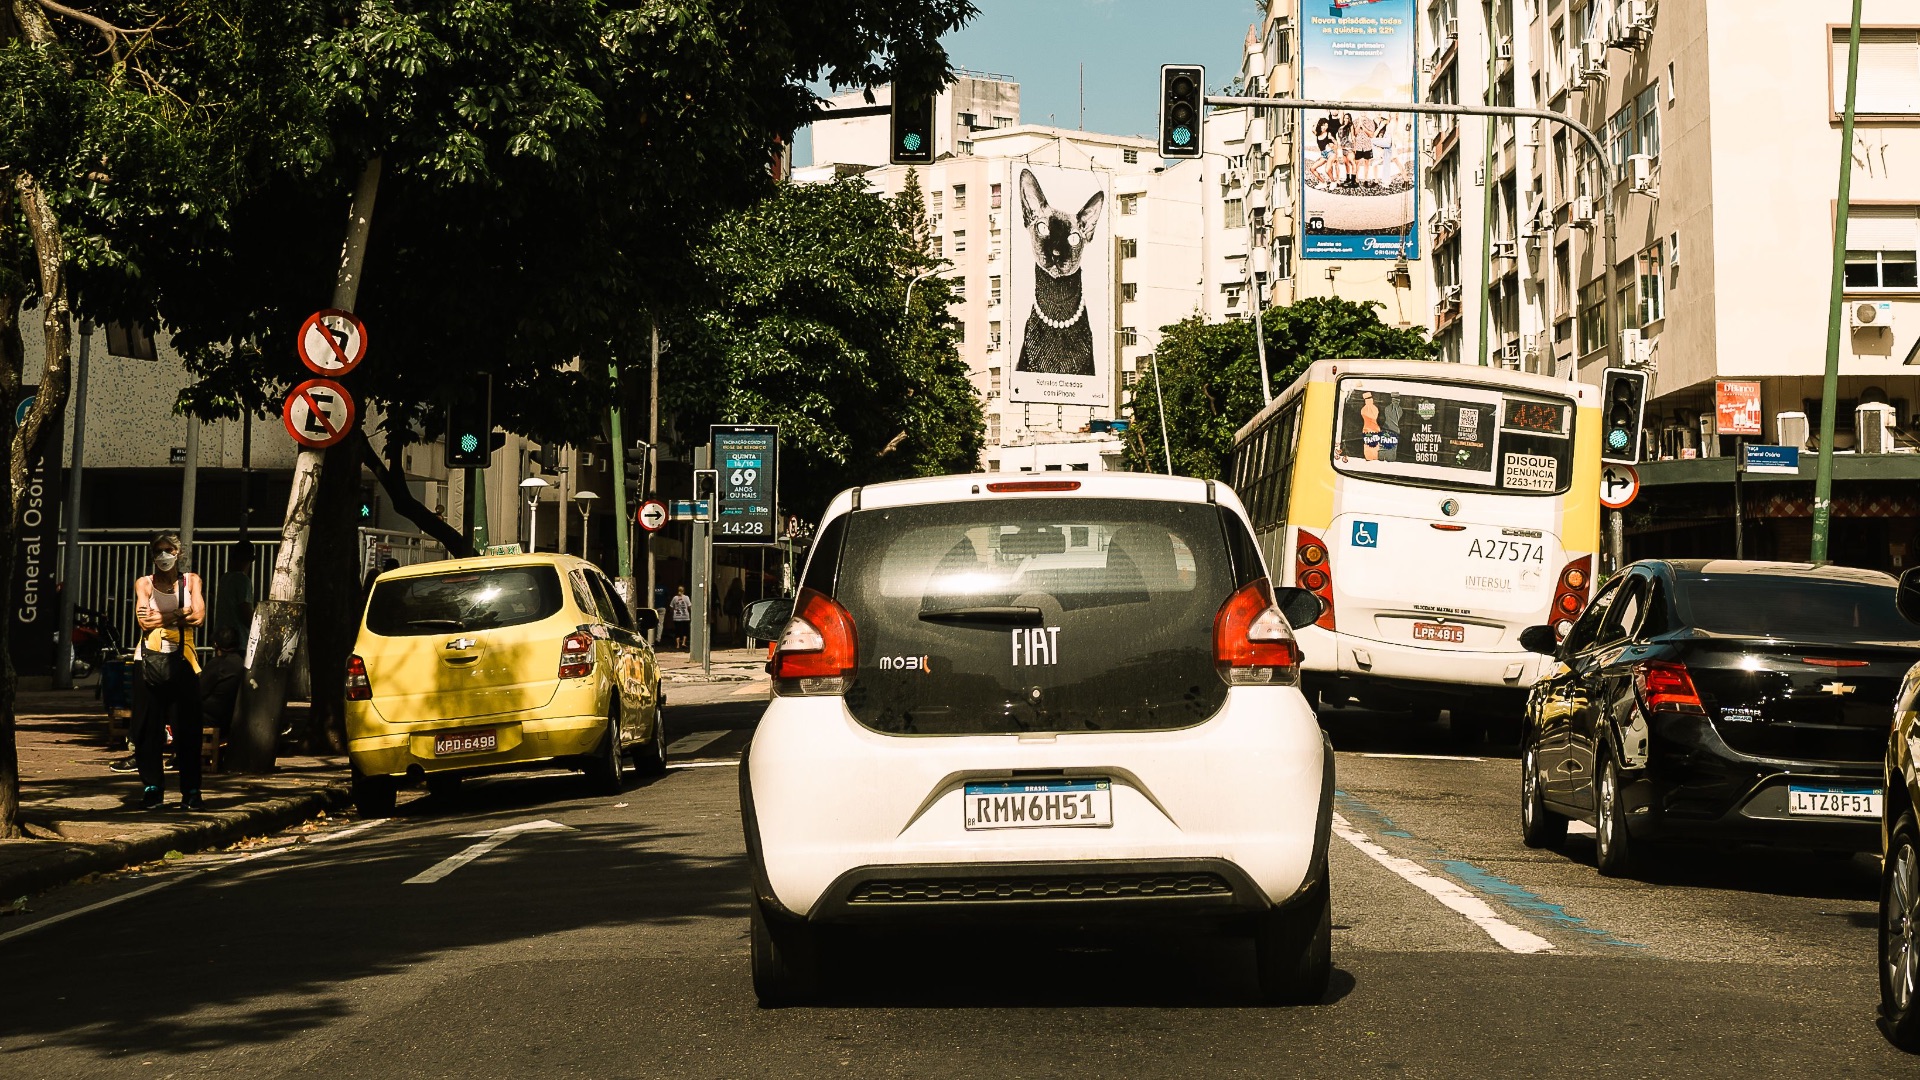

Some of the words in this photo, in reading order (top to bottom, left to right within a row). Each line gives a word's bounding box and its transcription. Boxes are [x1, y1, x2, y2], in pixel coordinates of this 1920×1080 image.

[1311, 16, 1336, 24] Novos
[1338, 16, 1378, 26] episódios,
[1380, 16, 1403, 25] todas
[1334, 26, 1366, 35] quintas,
[1357, 42, 1385, 50] primeiro
[1311, 220, 1322, 229] 16
[1056, 390, 1076, 398] iPhone
[1421, 424, 1432, 433] ME
[1411, 433, 1442, 443] ASSUSTA
[1414, 443, 1428, 452] QUE
[1429, 443, 1439, 453] EU
[1415, 452, 1438, 462] GOSTO
[1507, 455, 1555, 469] DISQUE
[730, 469, 757, 486] 69
[1506, 466, 1554, 479] DENÚNCIA
[1506, 477, 1554, 489] 2253-1177
[722, 522, 764, 534] 14:28
[1468, 539, 1544, 564] A27574
[18, 535, 41, 623] General
[1465, 576, 1512, 590] INTERSUL
[1012, 626, 1061, 666] FIAT
[977, 793, 1095, 823] RMW6H51
[1798, 793, 1872, 813] LTZ8F51
[967, 817, 976, 826] BR
